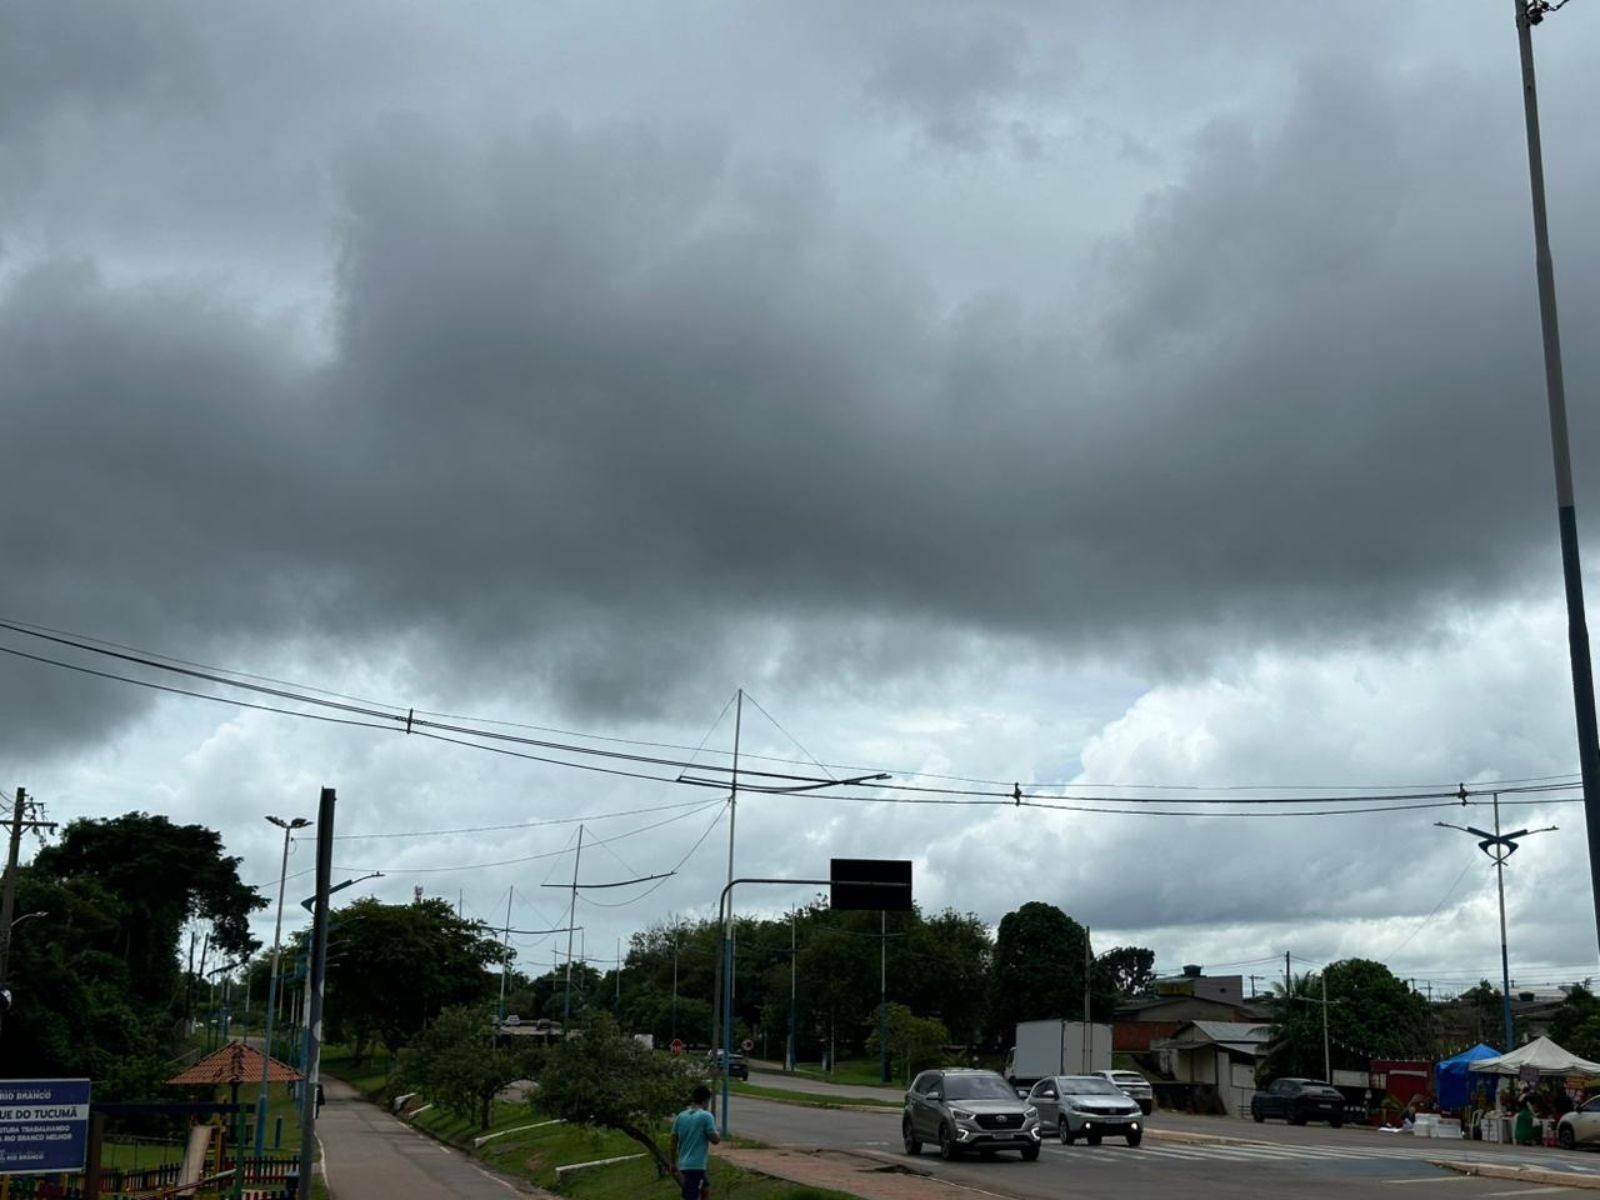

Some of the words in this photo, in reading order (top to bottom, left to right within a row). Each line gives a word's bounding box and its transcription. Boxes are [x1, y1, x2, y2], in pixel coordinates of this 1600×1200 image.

[16, 1091, 52, 1100] BRANCO
[15, 1110, 32, 1119] DO
[34, 1106, 78, 1119] TUCUMÃ
